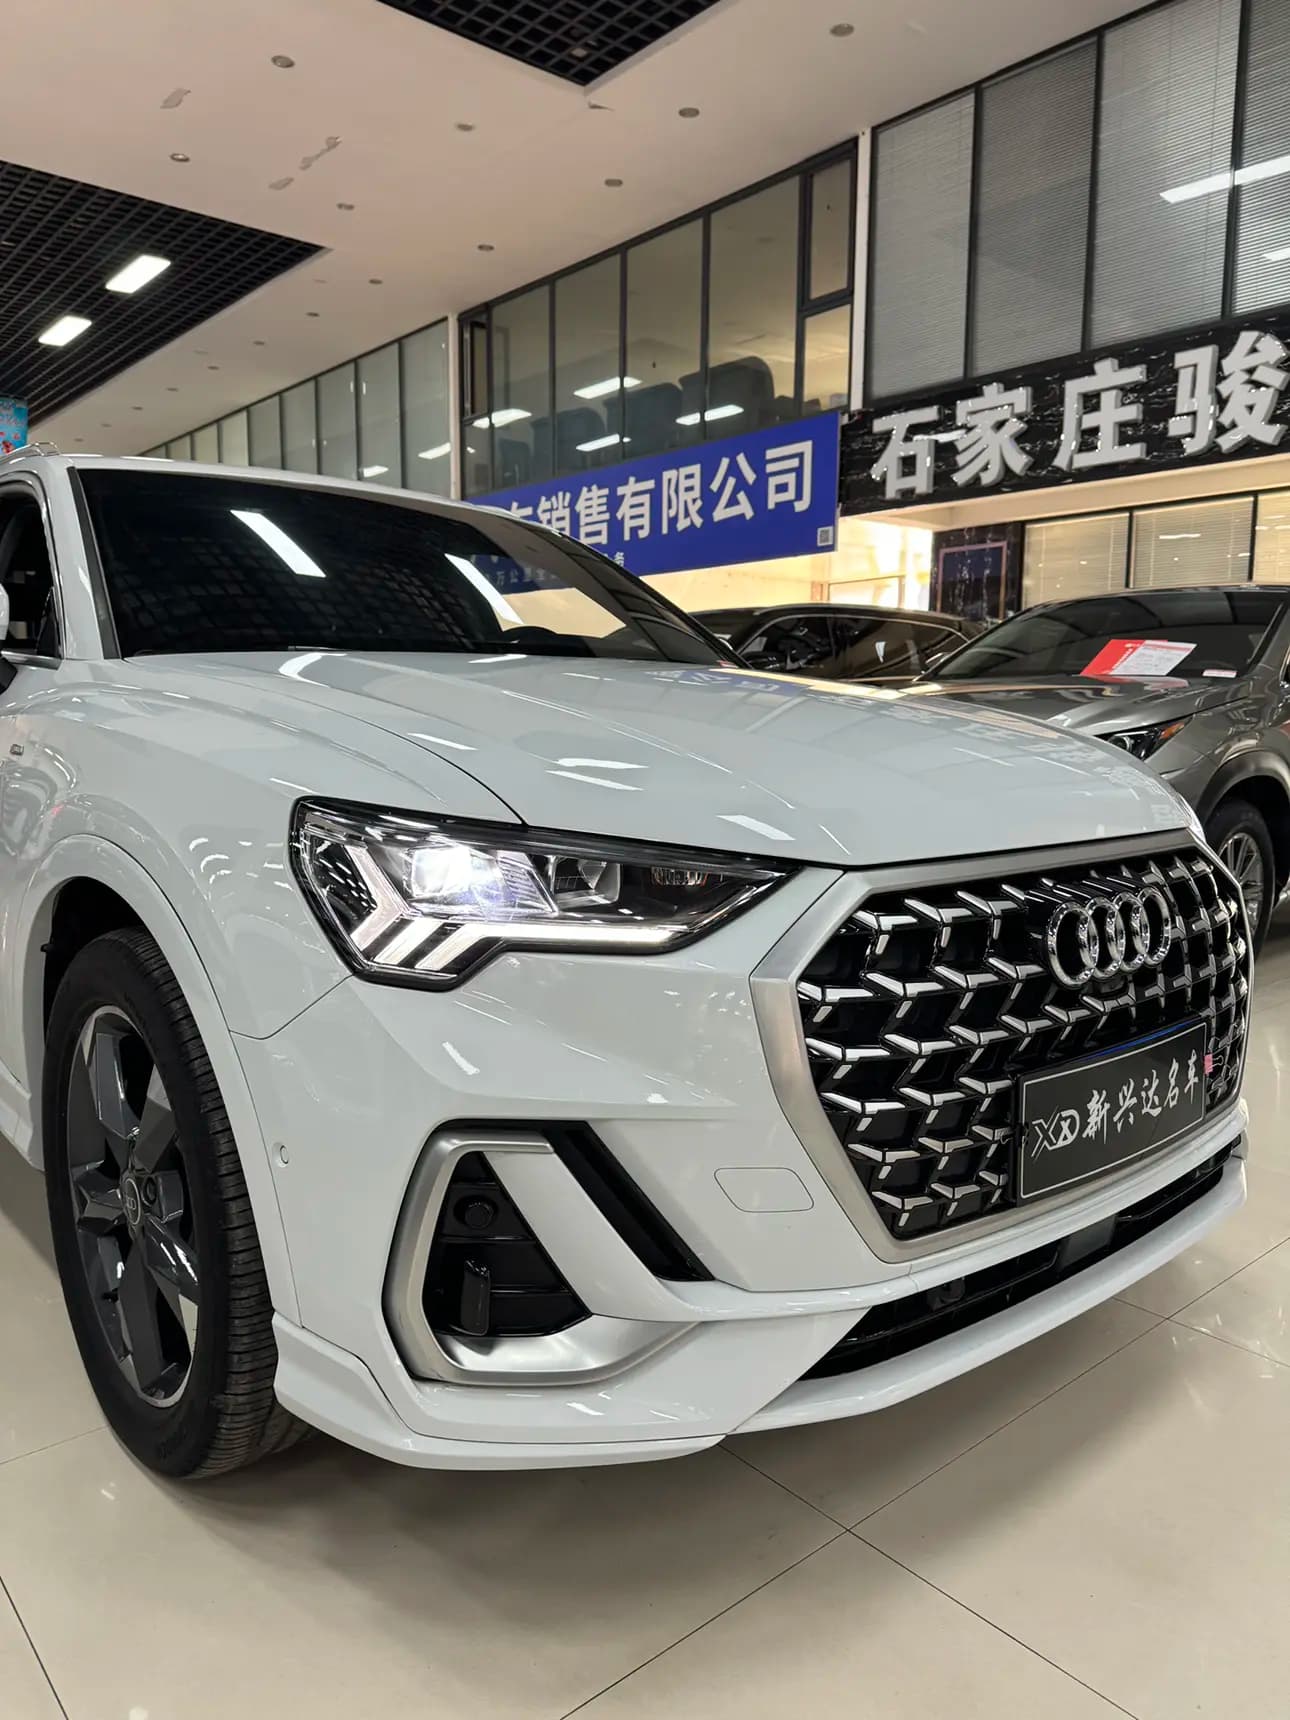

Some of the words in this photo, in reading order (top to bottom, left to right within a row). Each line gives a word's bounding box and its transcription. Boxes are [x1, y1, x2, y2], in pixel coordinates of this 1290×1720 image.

[870, 330, 1290, 500] 石家庄骏
[1082, 1049, 1199, 1145] 新兴达名车
